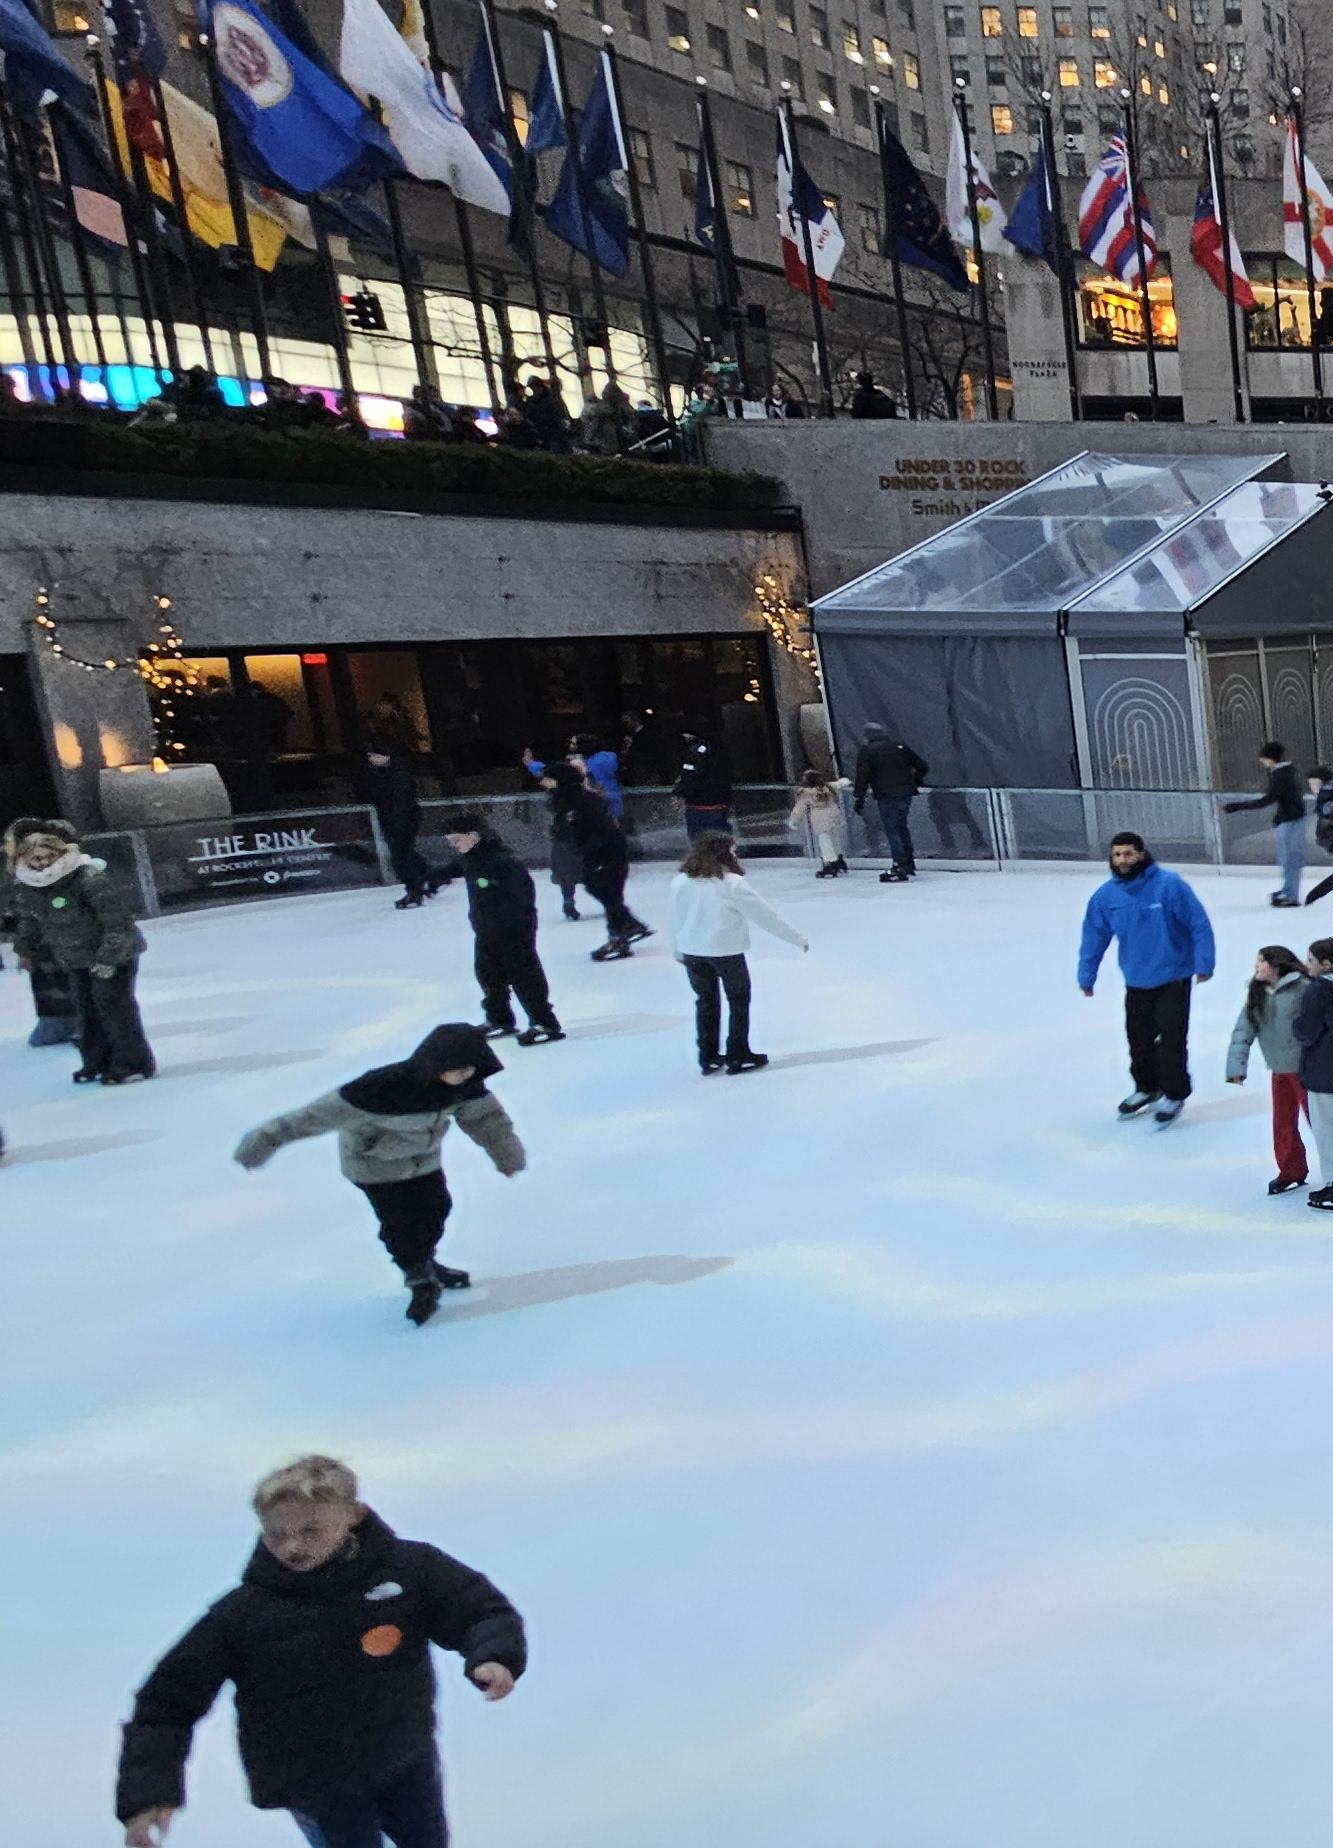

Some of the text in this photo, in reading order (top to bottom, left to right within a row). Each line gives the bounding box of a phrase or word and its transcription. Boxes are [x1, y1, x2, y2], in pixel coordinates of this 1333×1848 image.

[894, 458, 1025, 474] UNDER 30 ROCK
[878, 475, 939, 491] DINING
[911, 499, 961, 516] Smith
[196, 828, 316, 857] THE RINK
